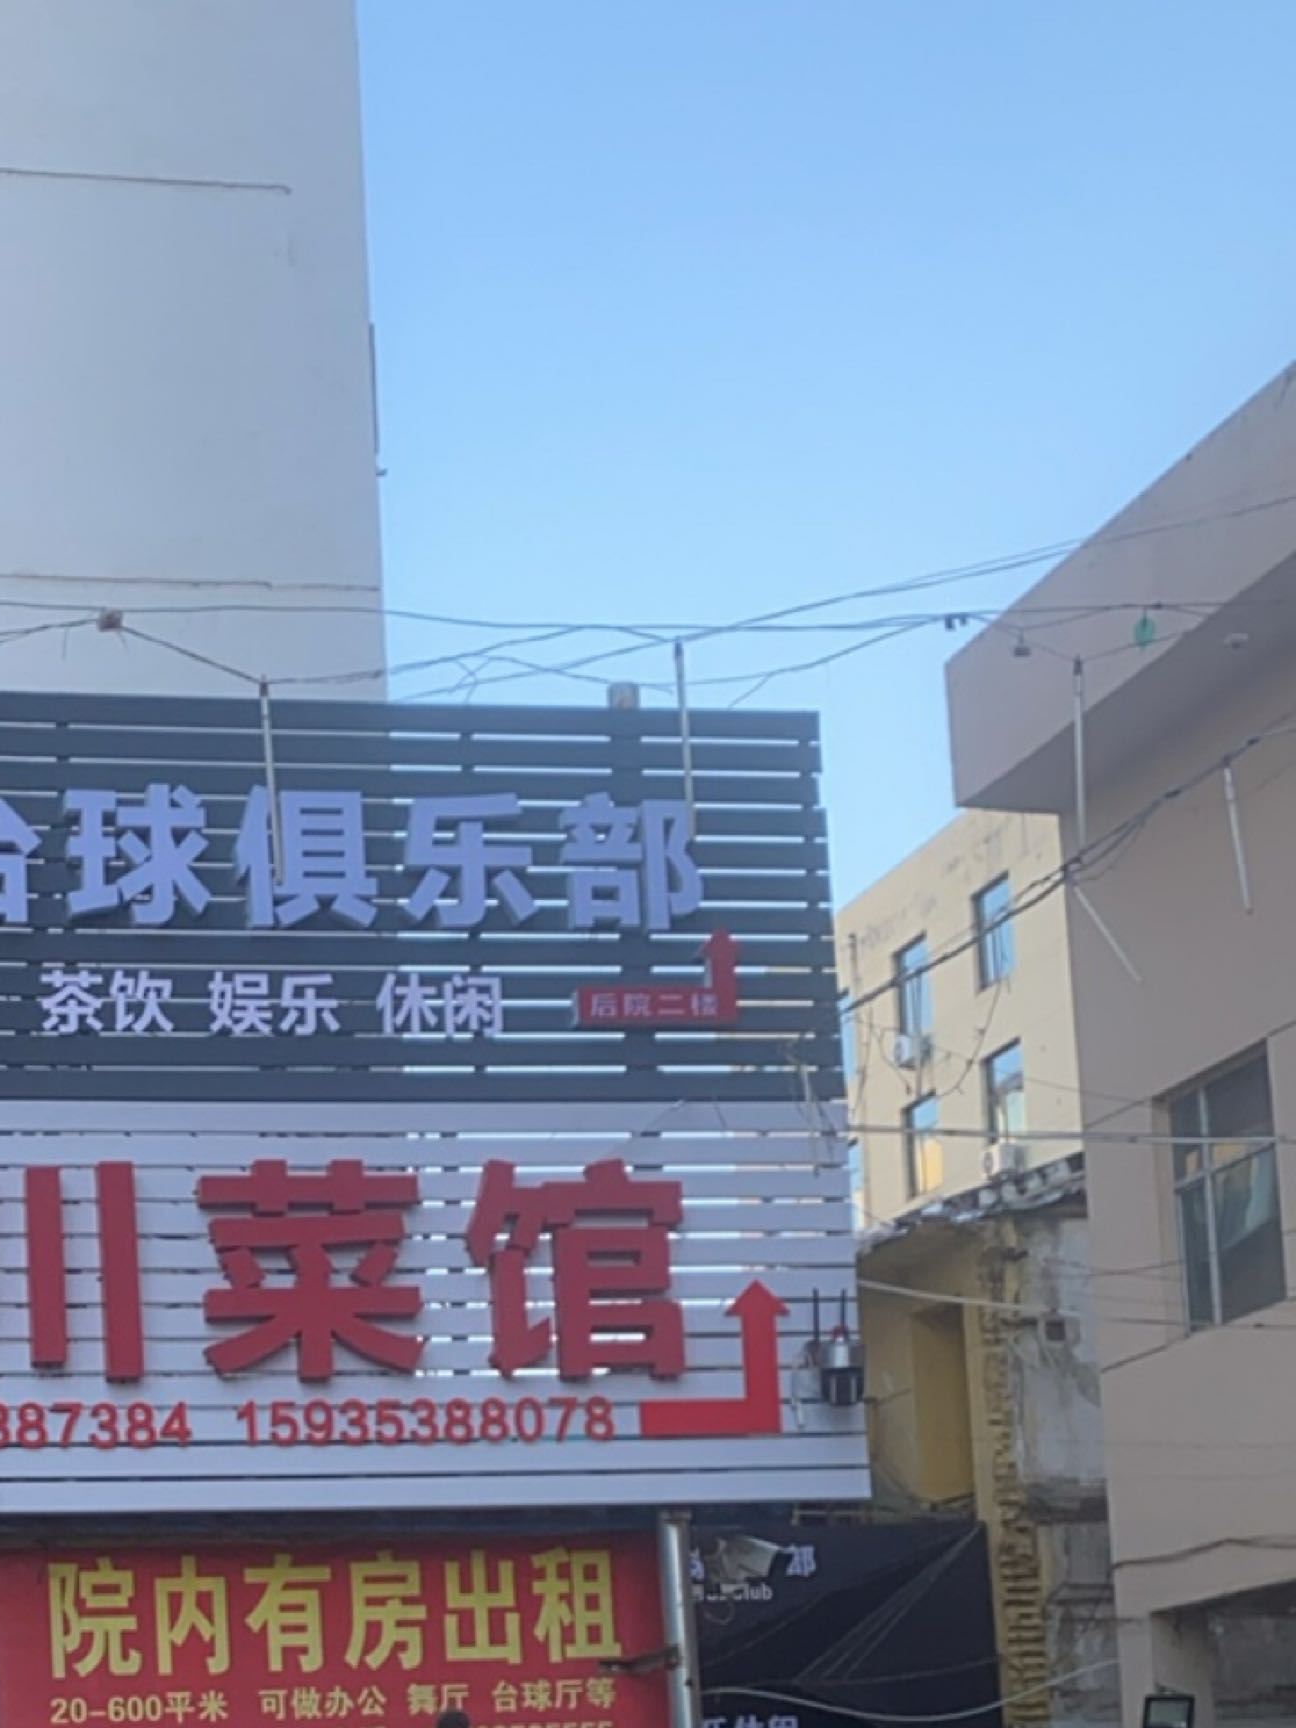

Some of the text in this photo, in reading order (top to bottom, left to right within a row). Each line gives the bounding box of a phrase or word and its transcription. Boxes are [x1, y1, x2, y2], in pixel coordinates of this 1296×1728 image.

[39, 969, 505, 1039] 茶饮 娱乐 休闲
[236, 1395, 615, 1447] 15935388078
[48, 1548, 623, 1679] 院内有房出租
[50, 1676, 616, 1724] 20-600平米 可做办公 舞厅 台球厅等
